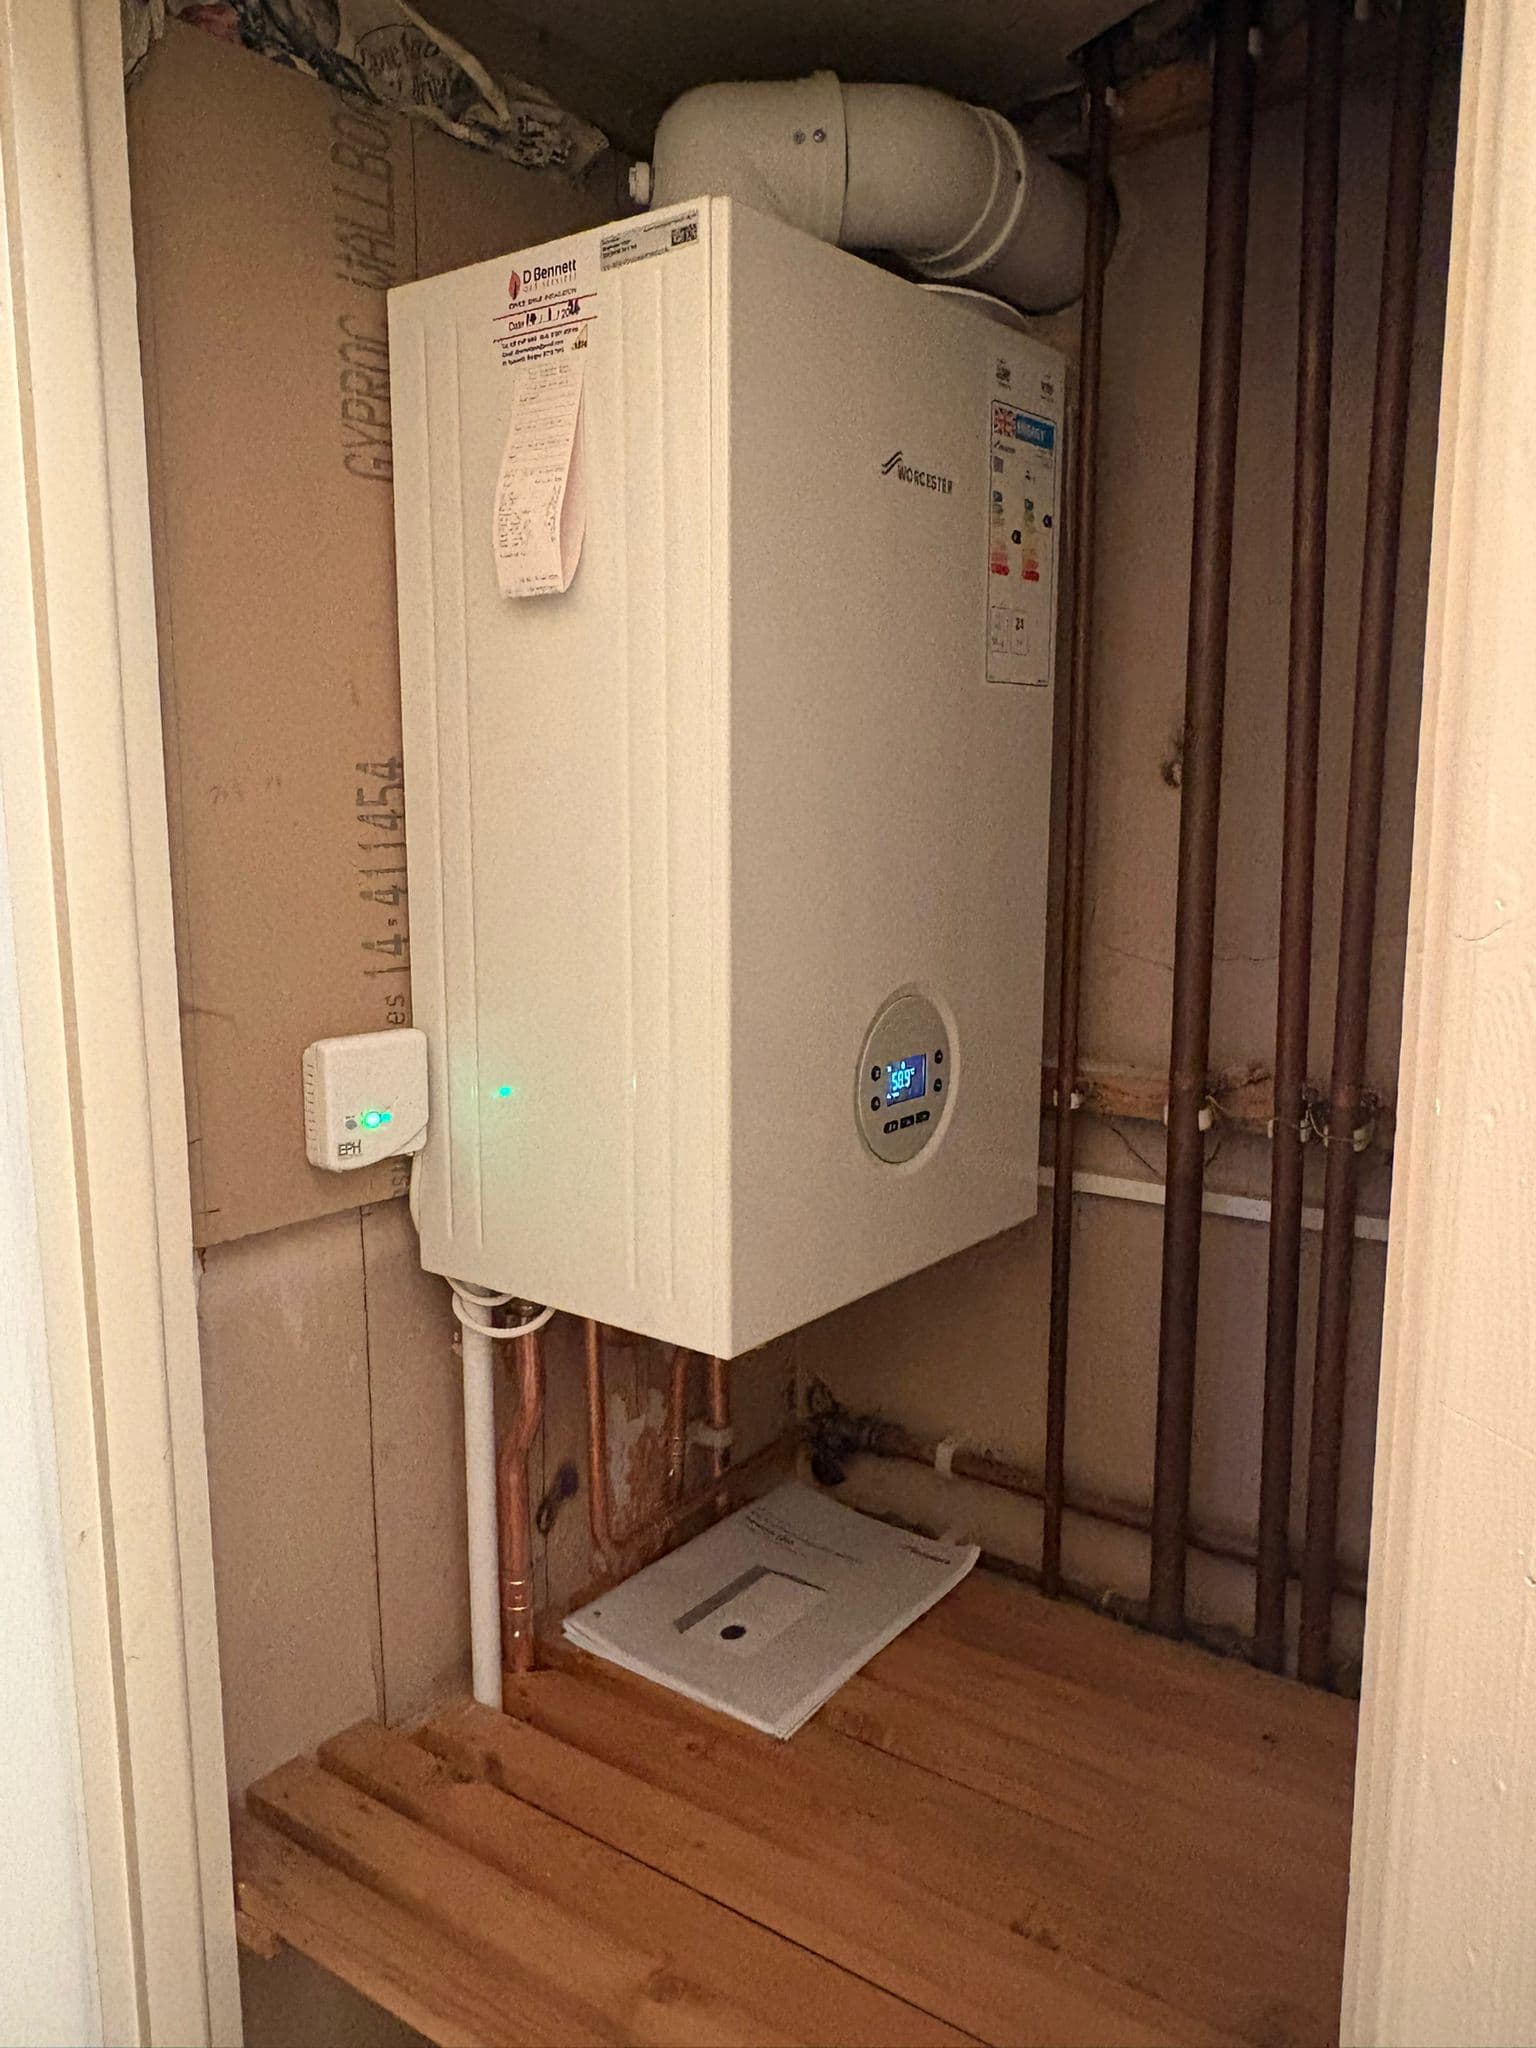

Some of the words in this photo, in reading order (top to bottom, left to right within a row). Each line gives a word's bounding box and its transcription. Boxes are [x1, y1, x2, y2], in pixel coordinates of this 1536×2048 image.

[522, 270, 532, 284] D
[533, 259, 577, 281] Bennett
[897, 464, 953, 494] WORCESTER
[337, 1139, 361, 1156] EPH
